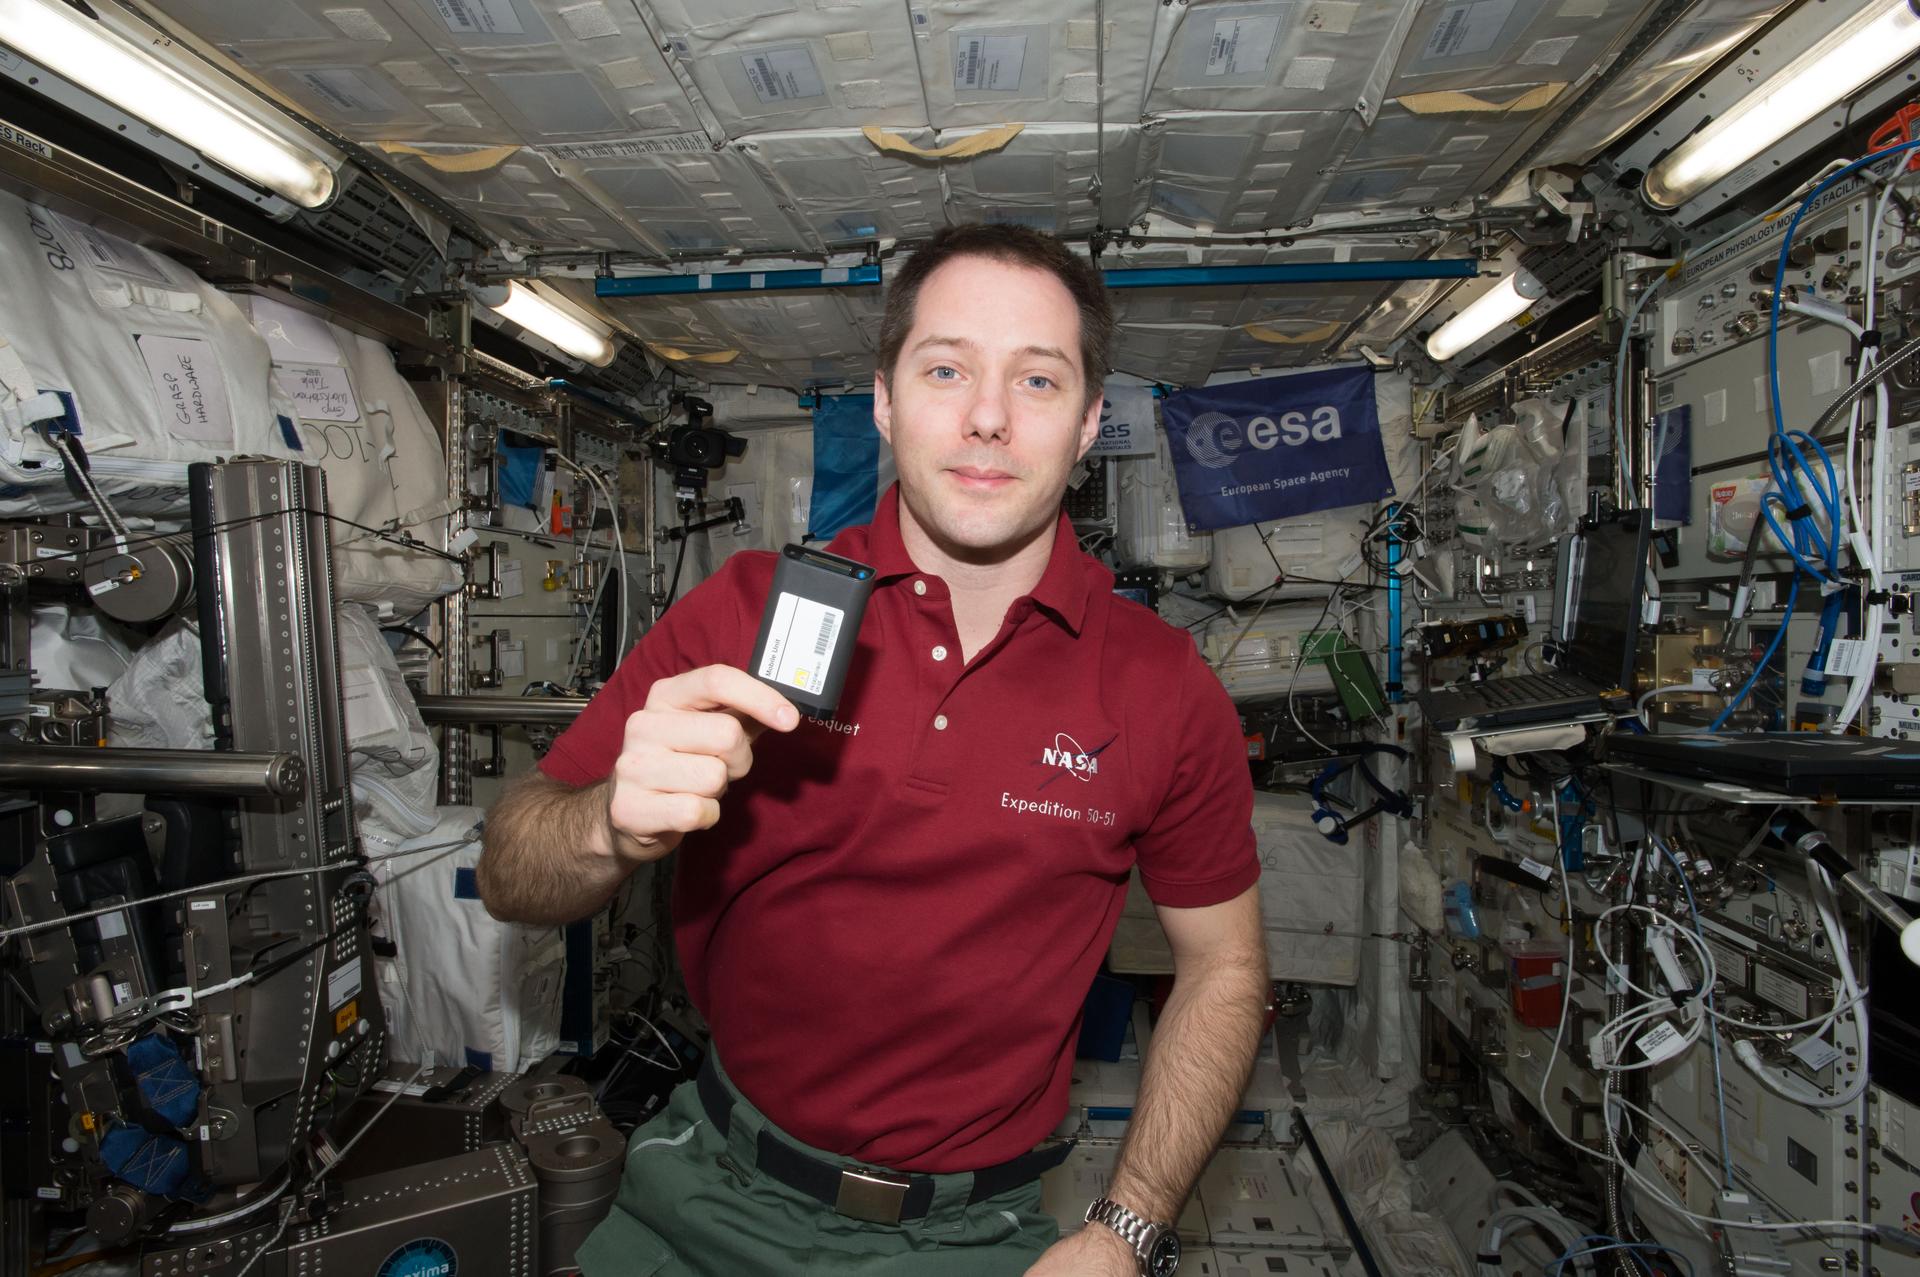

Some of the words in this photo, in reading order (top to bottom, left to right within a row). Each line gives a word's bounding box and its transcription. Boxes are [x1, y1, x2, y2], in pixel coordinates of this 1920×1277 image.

[16, 133, 46, 155] Rack
[1686, 249, 1725, 278] EUROPEAN
[1725, 224, 1776, 255] PHYSIOLOGY
[1776, 203, 1821, 231] MODES
[163, 372, 191, 426] GRASP
[176, 354, 208, 424] HARDWARE
[1098, 423, 1131, 439] es
[1247, 405, 1343, 451] esa
[1220, 480, 1272, 497] European
[1273, 475, 1307, 493] Space
[1310, 466, 1351, 483] Agency
[765, 653, 777, 677] Mobile
[772, 638, 781, 653] Unit
[800, 713, 860, 736] esquet
[1042, 747, 1098, 774] NASA
[1001, 792, 1081, 820] Expedition
[1087, 808, 1116, 826] 50-51
[404, 1262, 450, 1277] xima
